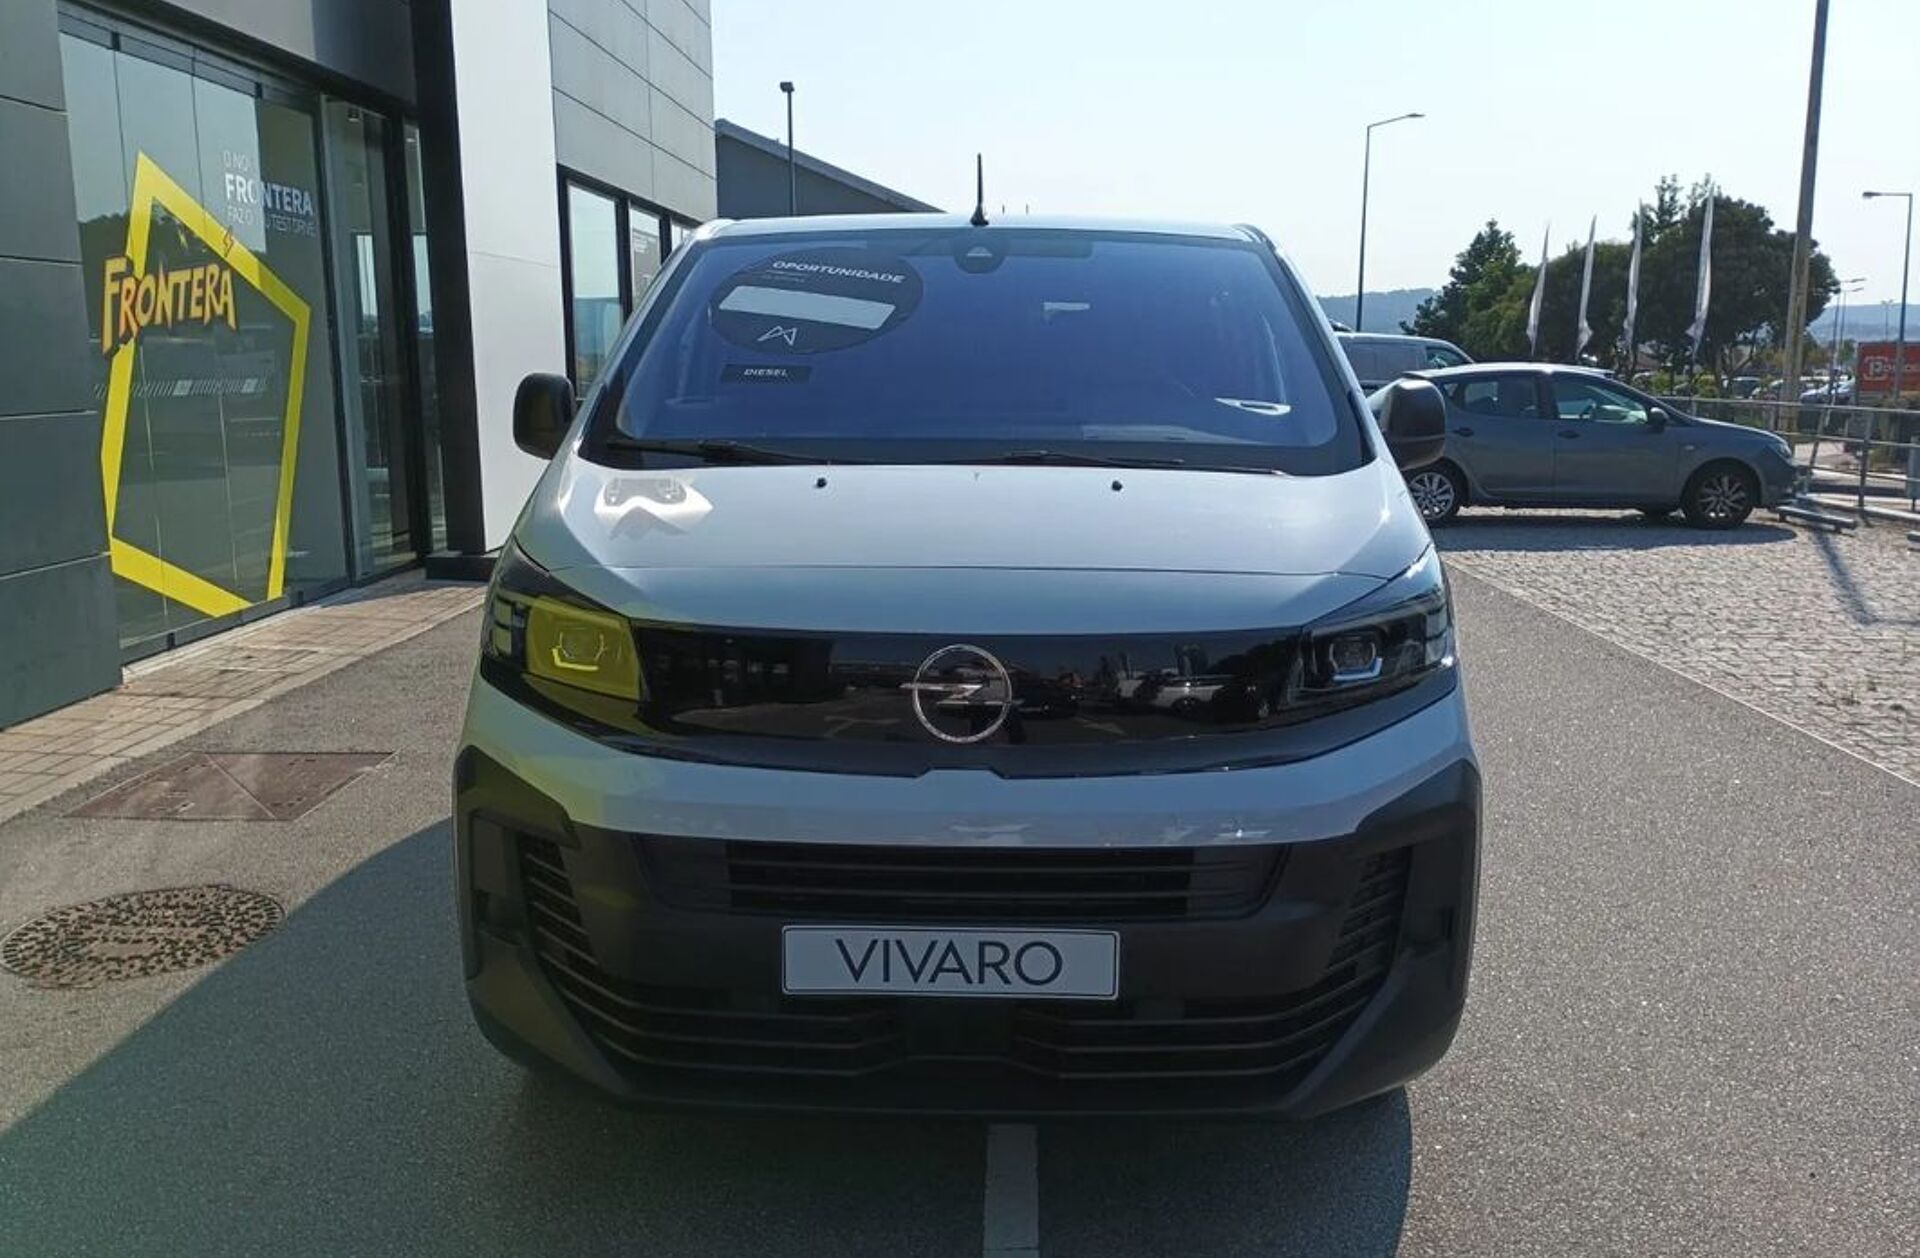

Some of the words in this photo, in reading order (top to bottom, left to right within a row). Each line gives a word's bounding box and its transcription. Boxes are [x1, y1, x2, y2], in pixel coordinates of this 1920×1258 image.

[225, 173, 312, 215] FRONTERA
[772, 260, 905, 283] OPORTUNIDADE
[743, 367, 788, 377] DIESEL
[834, 938, 1064, 987] VIVARO
